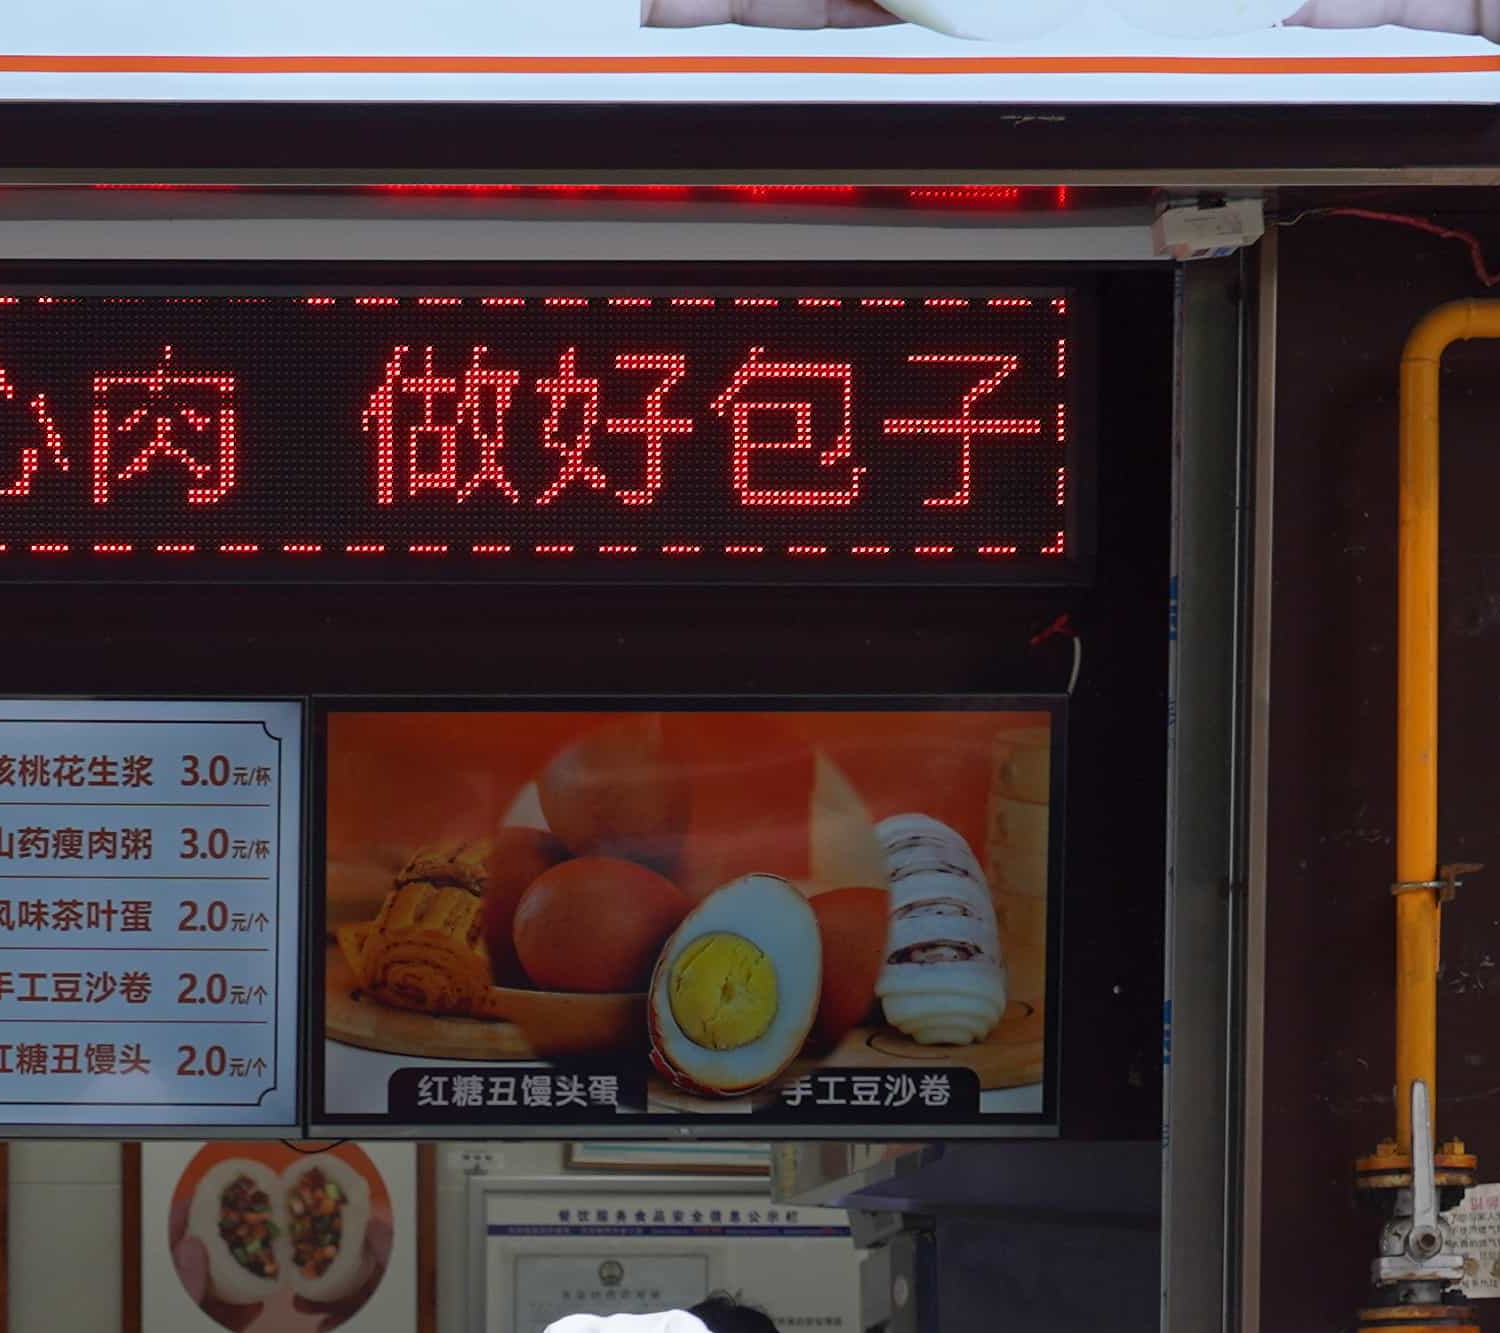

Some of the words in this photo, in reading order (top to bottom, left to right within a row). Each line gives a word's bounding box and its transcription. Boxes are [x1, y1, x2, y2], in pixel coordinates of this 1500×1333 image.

[362, 344, 1041, 504] 做好包子
[416, 1075, 621, 1107] 红糖丑馒头蛋
[782, 1074, 952, 1107] 手工豆沙卷
